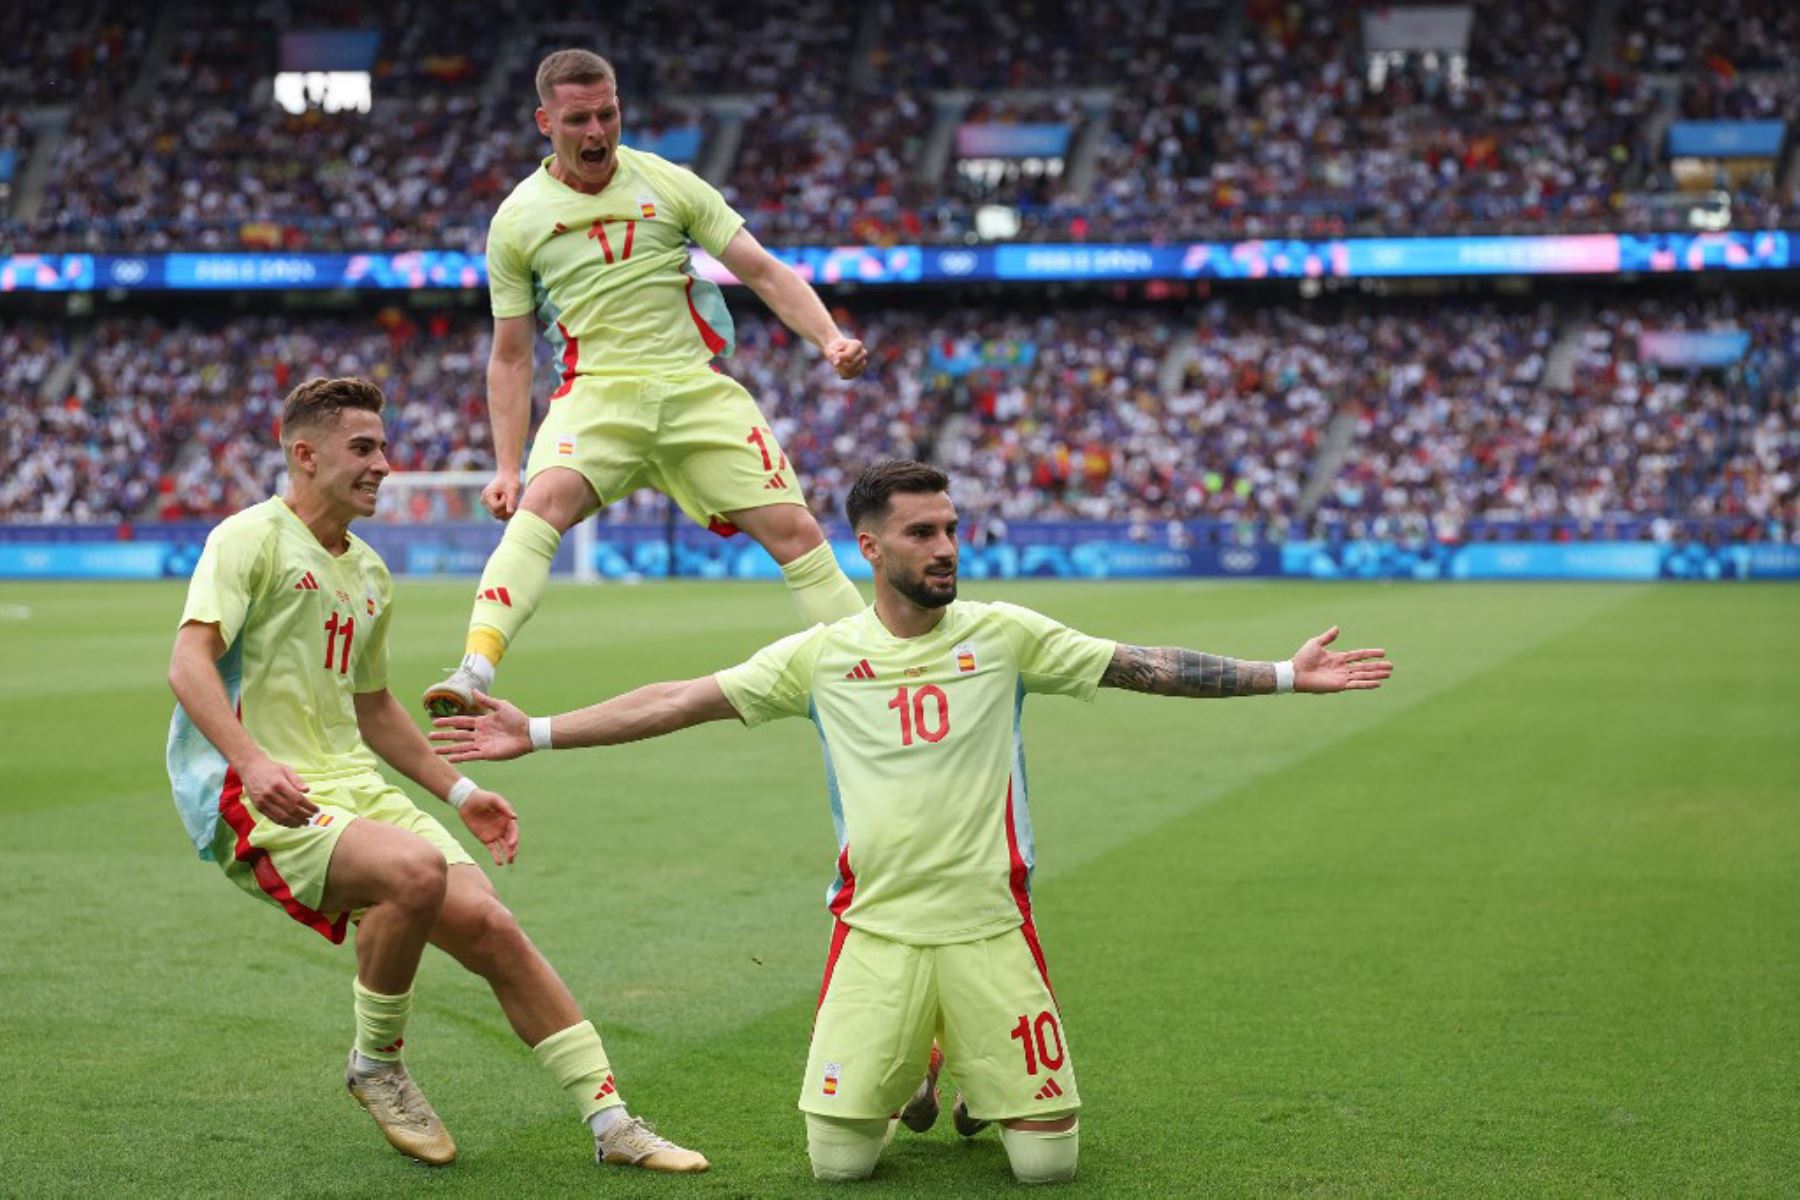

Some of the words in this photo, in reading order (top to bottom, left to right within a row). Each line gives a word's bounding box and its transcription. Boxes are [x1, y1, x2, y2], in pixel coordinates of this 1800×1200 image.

[587, 217, 635, 264] 17
[324, 611, 355, 674] 11
[888, 684, 950, 746] 10
[1010, 1011, 1065, 1075] 10
